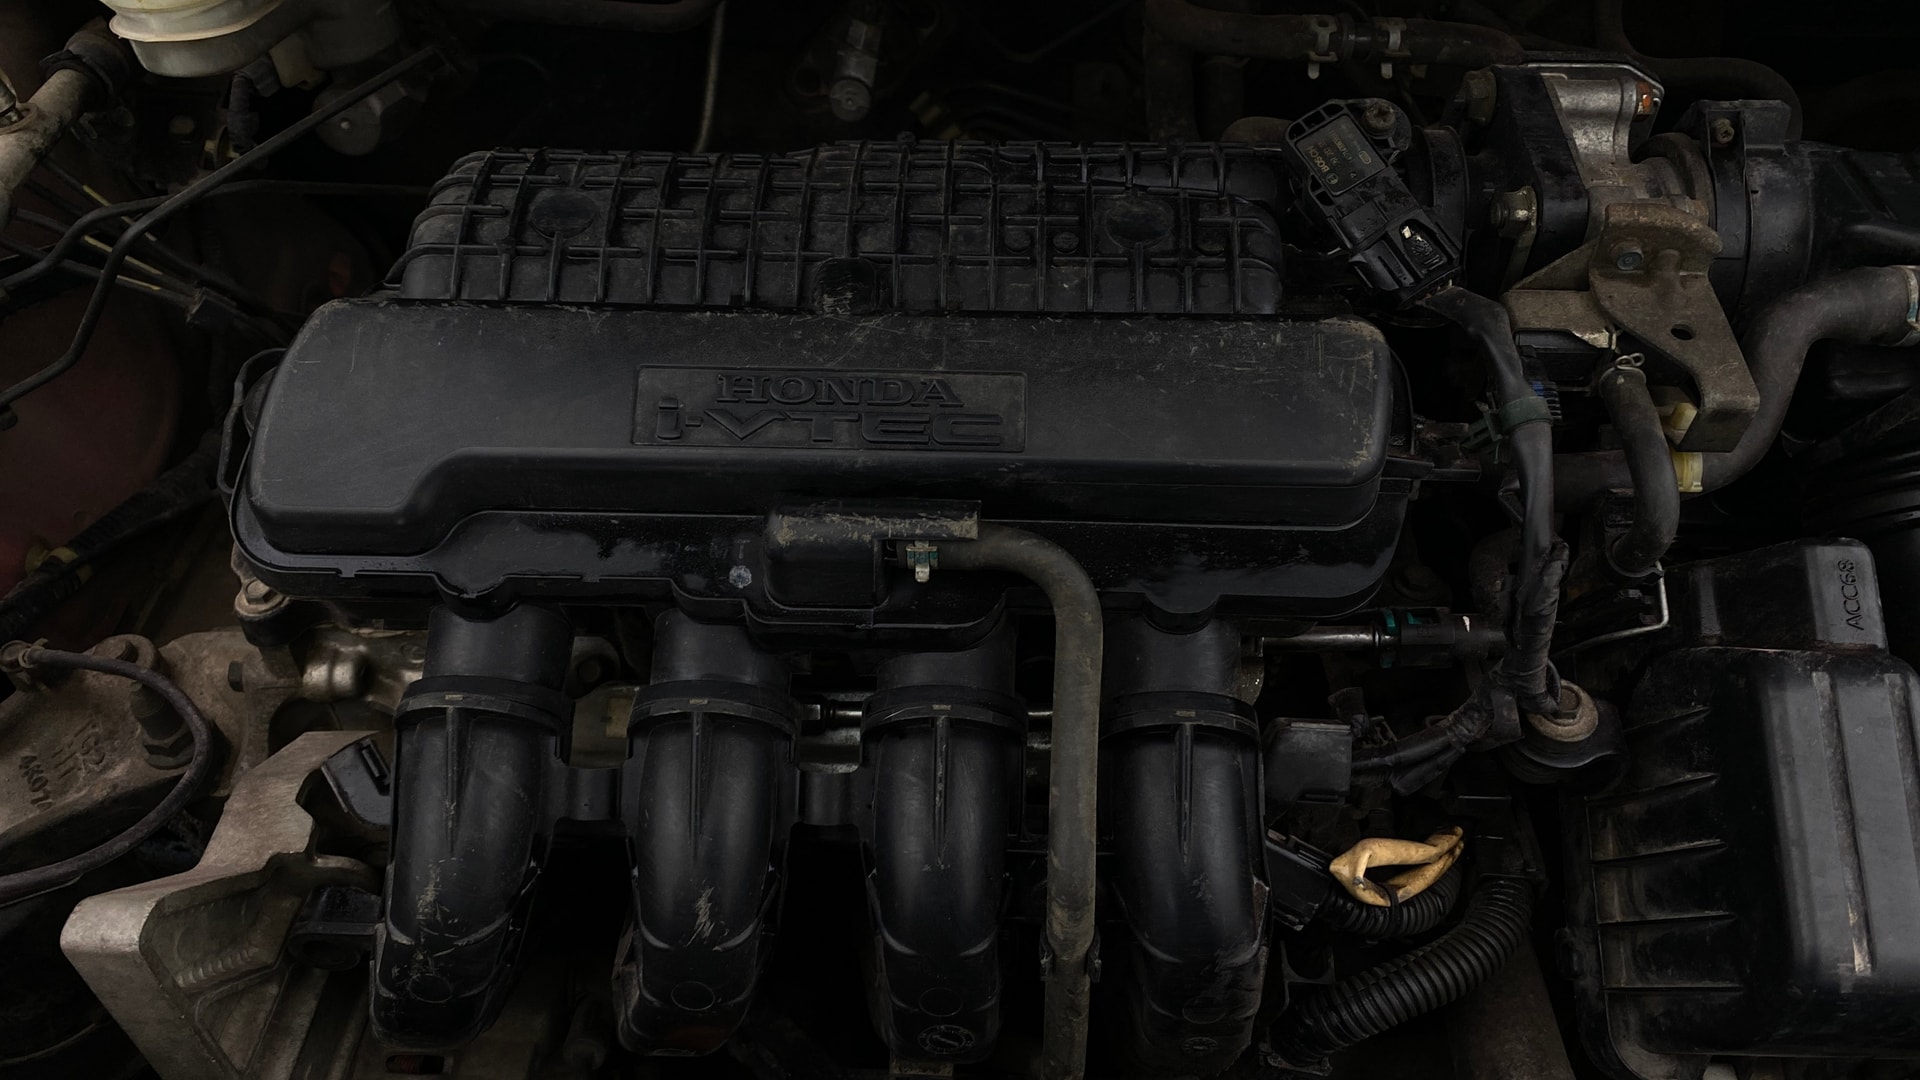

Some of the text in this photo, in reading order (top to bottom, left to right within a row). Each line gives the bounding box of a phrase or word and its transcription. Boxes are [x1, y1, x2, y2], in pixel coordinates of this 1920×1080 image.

[1306, 145, 1330, 173] BOSCH
[716, 374, 965, 408] HONDA
[656, 397, 1003, 447] i-VTEC
[1837, 559, 1865, 631] ACC68
